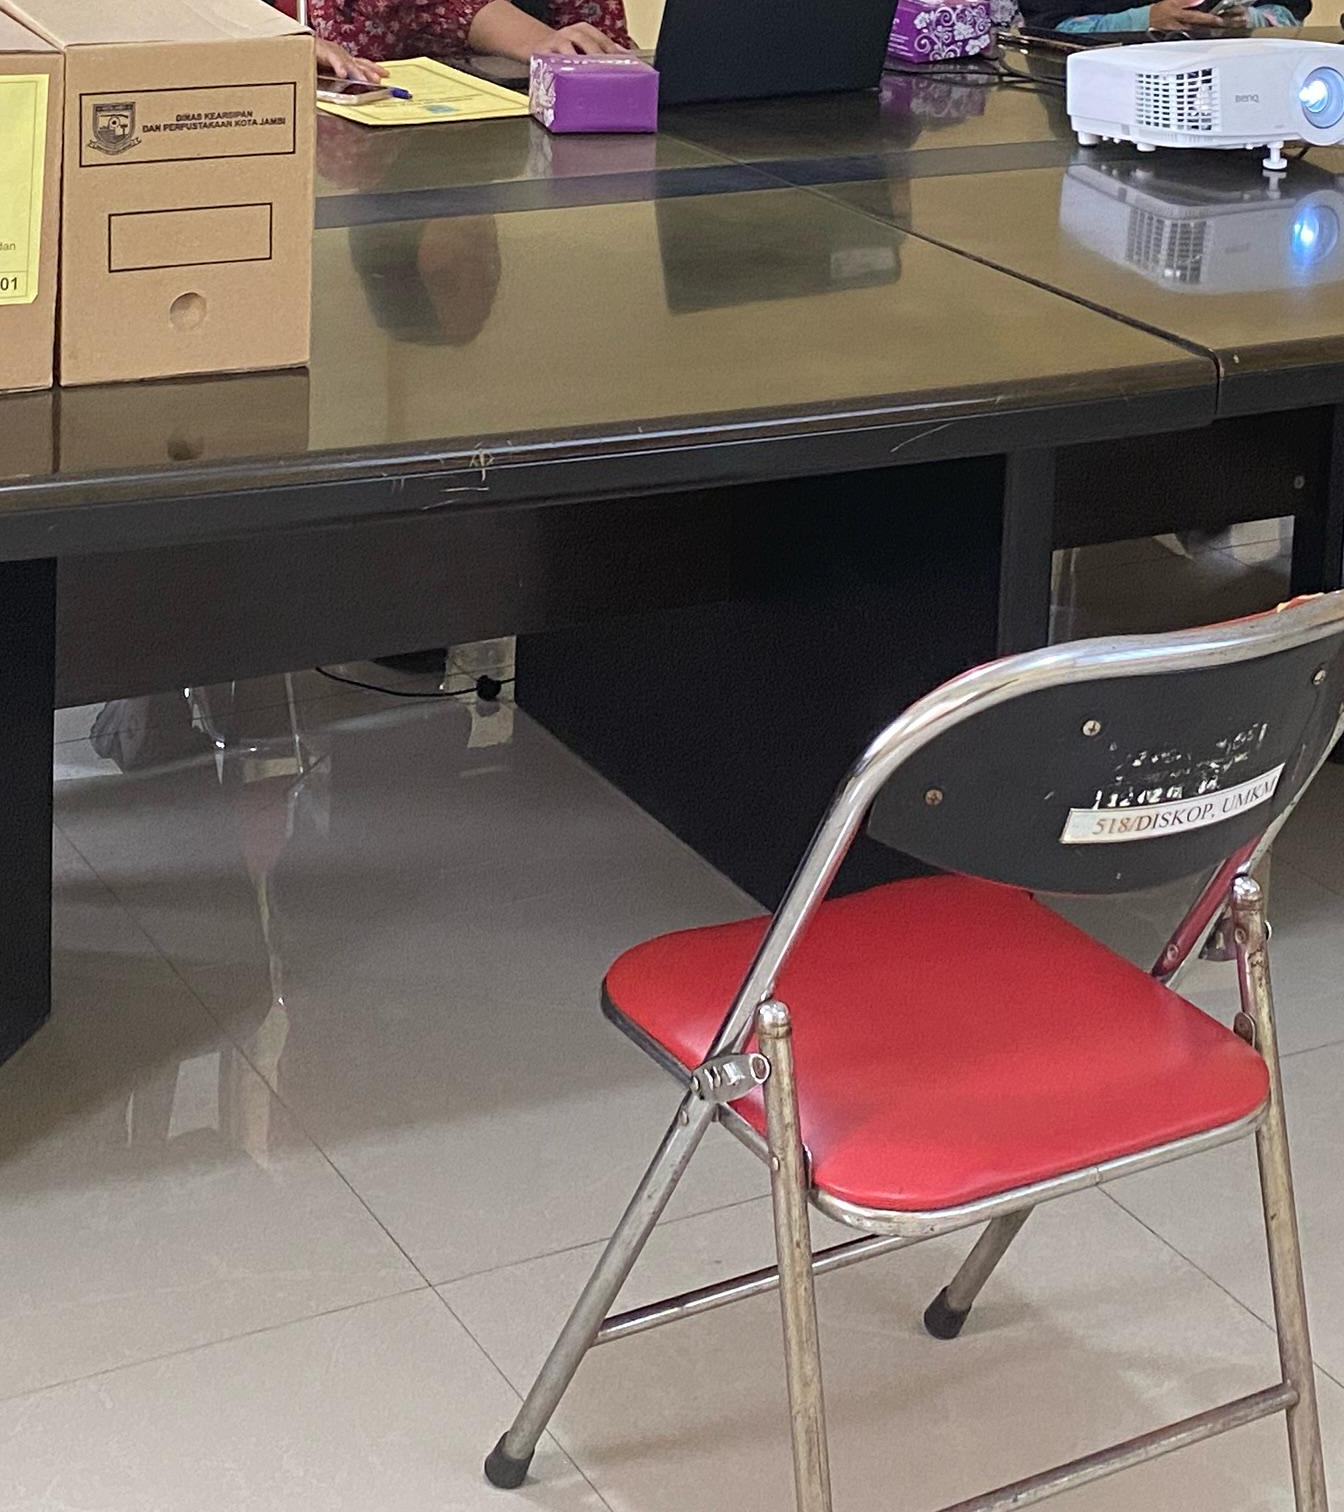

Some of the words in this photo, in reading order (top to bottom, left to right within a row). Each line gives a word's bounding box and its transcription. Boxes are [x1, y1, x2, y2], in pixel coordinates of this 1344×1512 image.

[142, 123, 161, 133] DAN
[163, 120, 233, 132] PERPUSTAKAAN
[234, 118, 258, 127] KOTA
[260, 116, 286, 126] JAMBI
[176, 113, 203, 122] DINAS
[204, 110, 253, 121] KEARSIPAN
[1221, 775, 1281, 814] UMKM
